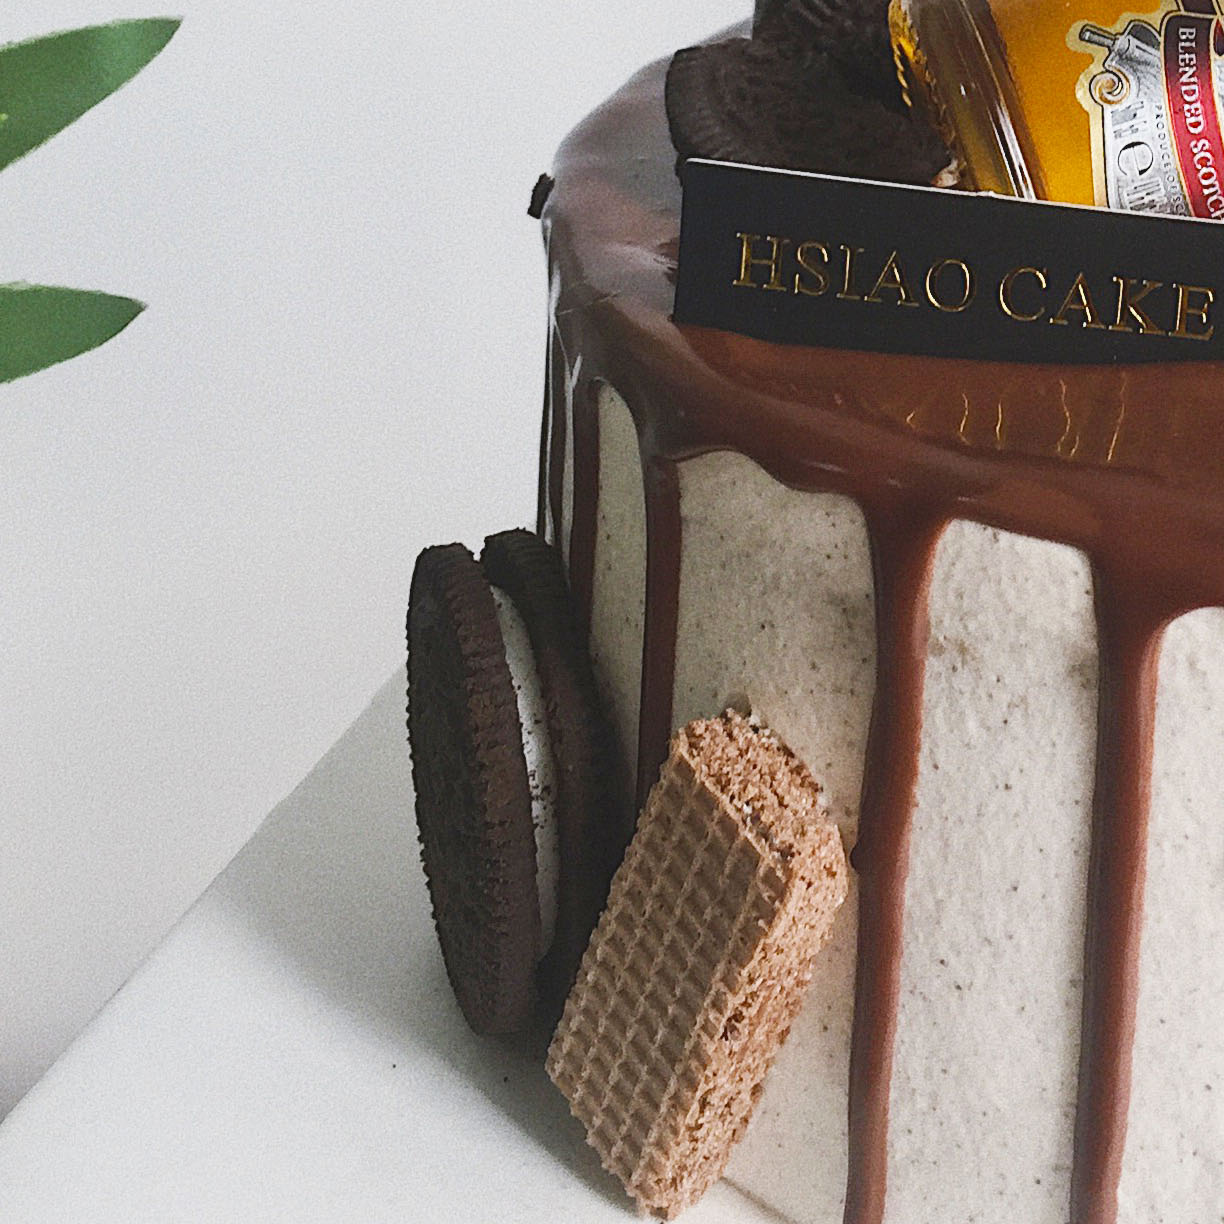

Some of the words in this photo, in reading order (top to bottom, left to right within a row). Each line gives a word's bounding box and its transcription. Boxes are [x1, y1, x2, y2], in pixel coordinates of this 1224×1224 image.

[1178, 26, 1206, 135] BLENDED
[731, 232, 976, 314] HSIAO
[998, 266, 1217, 342] CAKE
